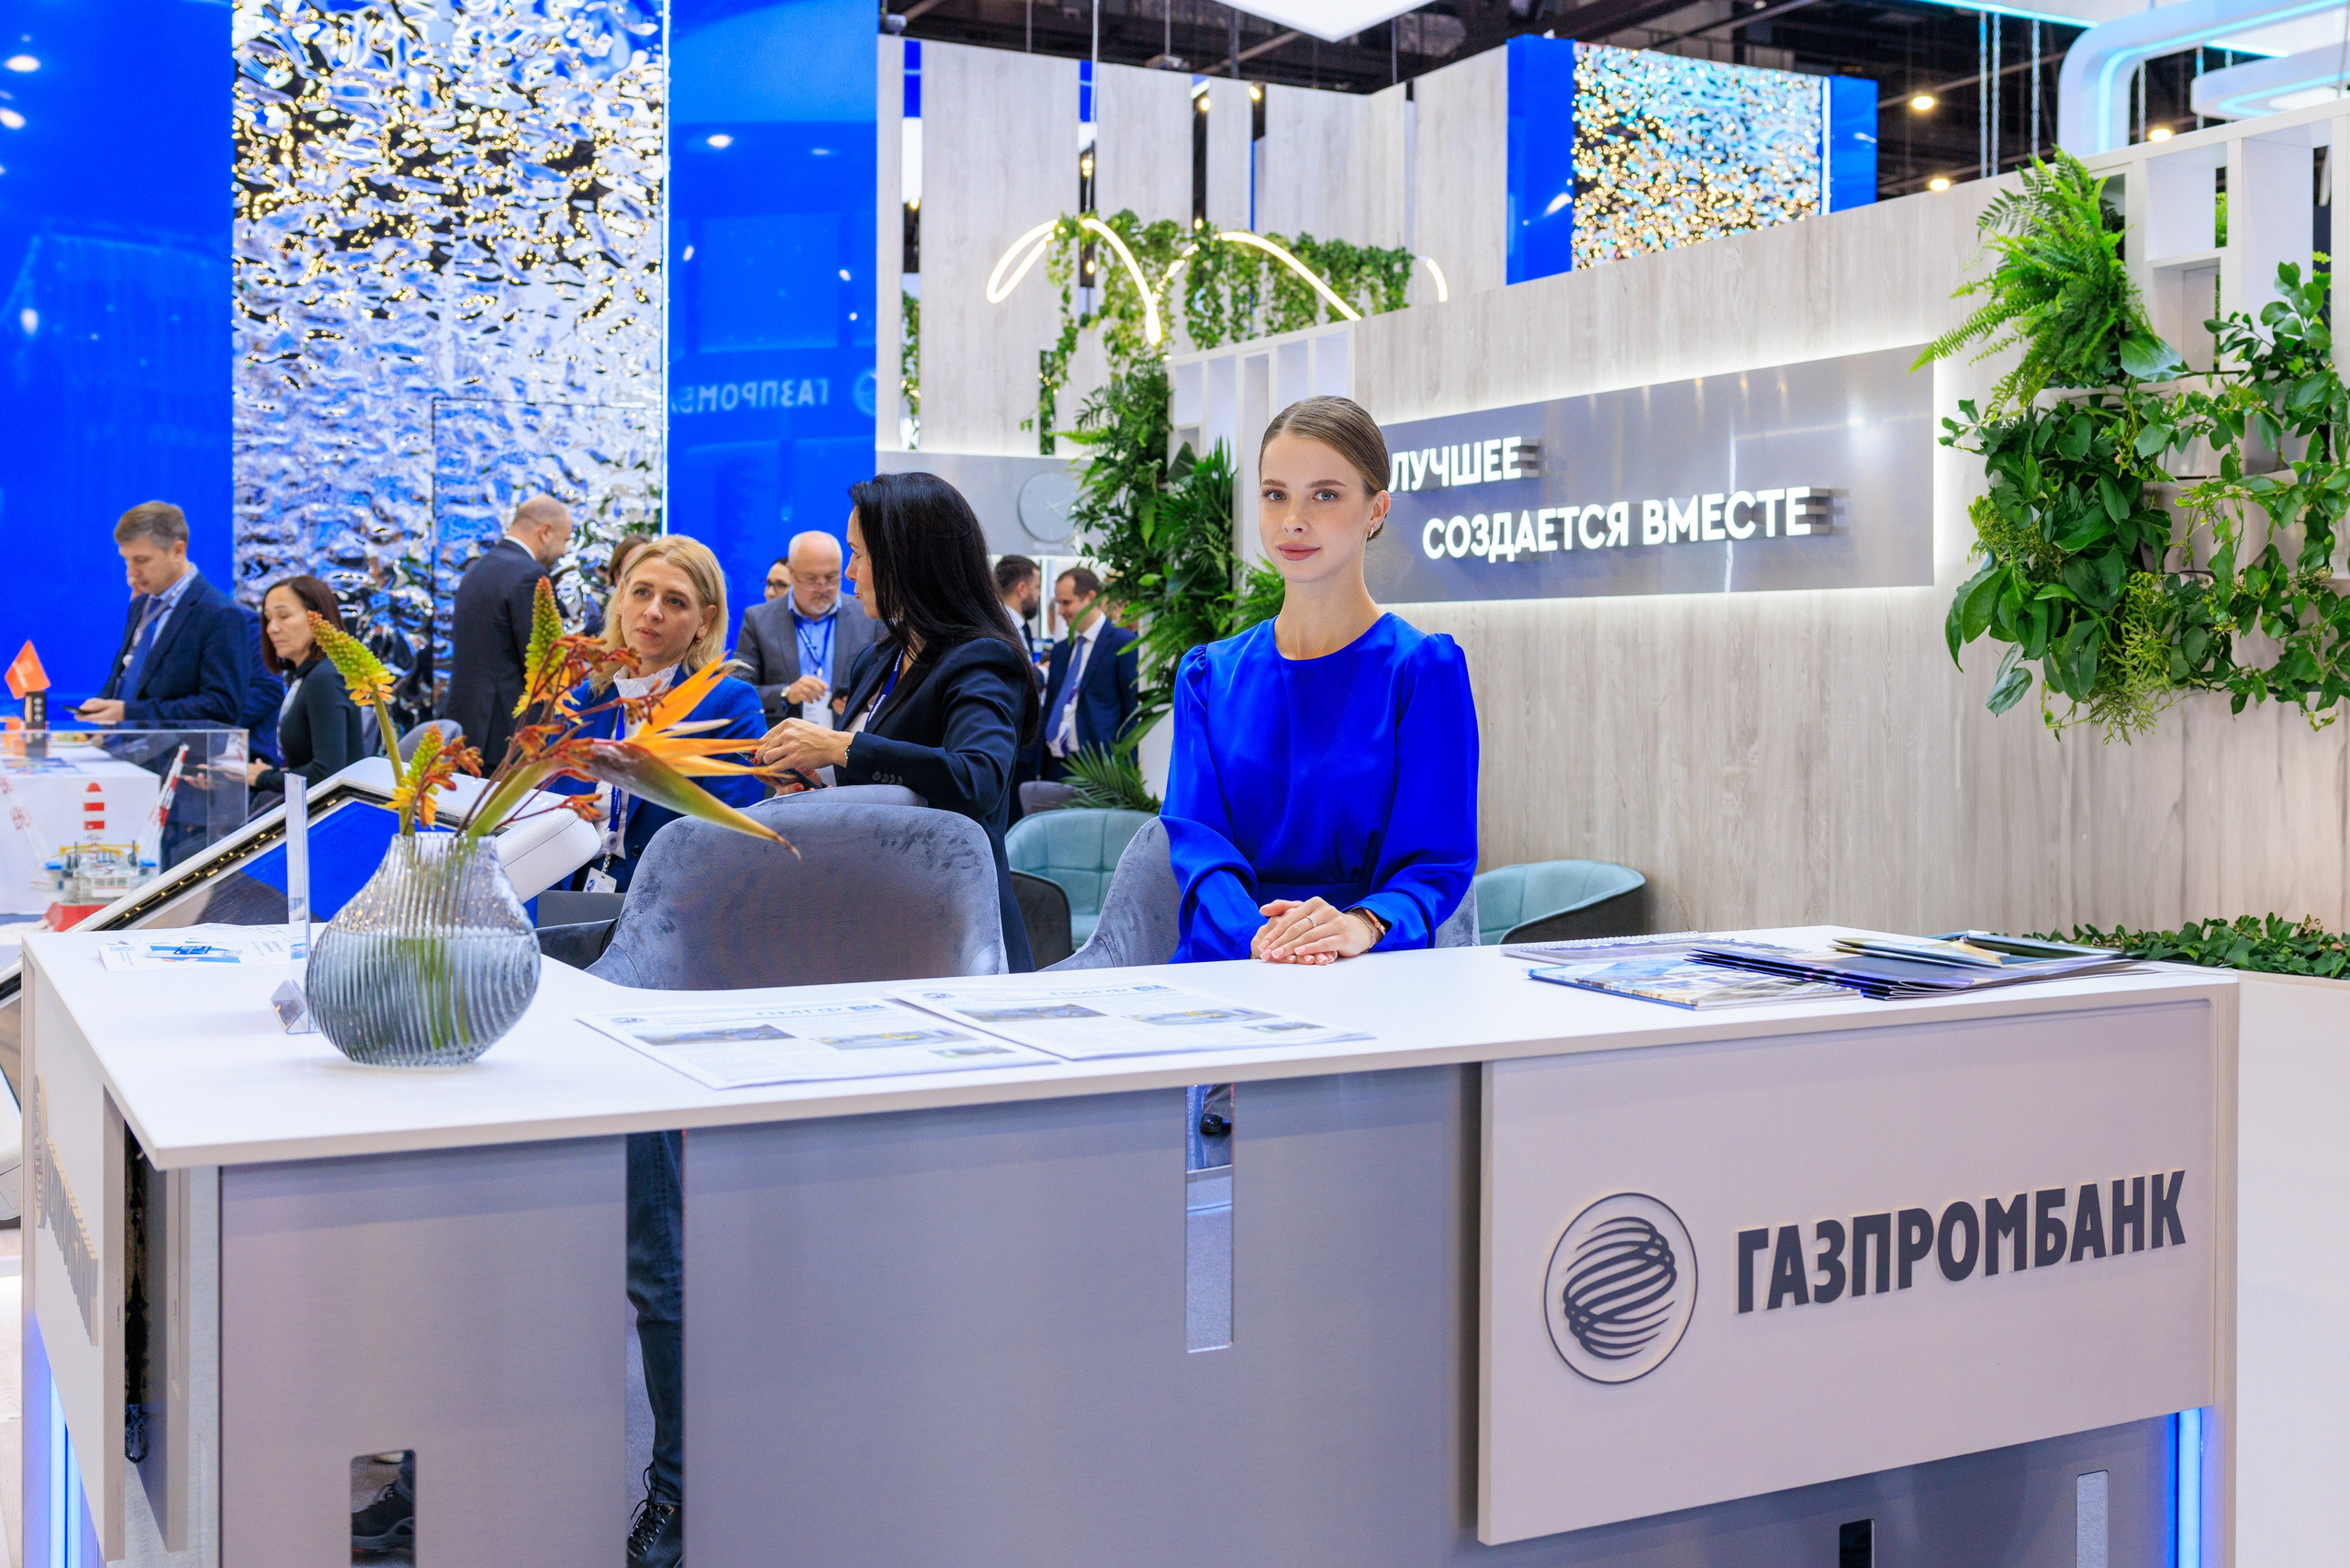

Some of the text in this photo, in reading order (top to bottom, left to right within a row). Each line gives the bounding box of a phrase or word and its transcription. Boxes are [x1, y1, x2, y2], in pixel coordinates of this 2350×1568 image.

[1388, 435, 1522, 493] ЛУЧШЕЕ
[1422, 486, 1811, 563] СОЗДАЕТСЯ ВМЕСТЕ
[1735, 1170, 2187, 1314] ГАЗПРОМБАНК
